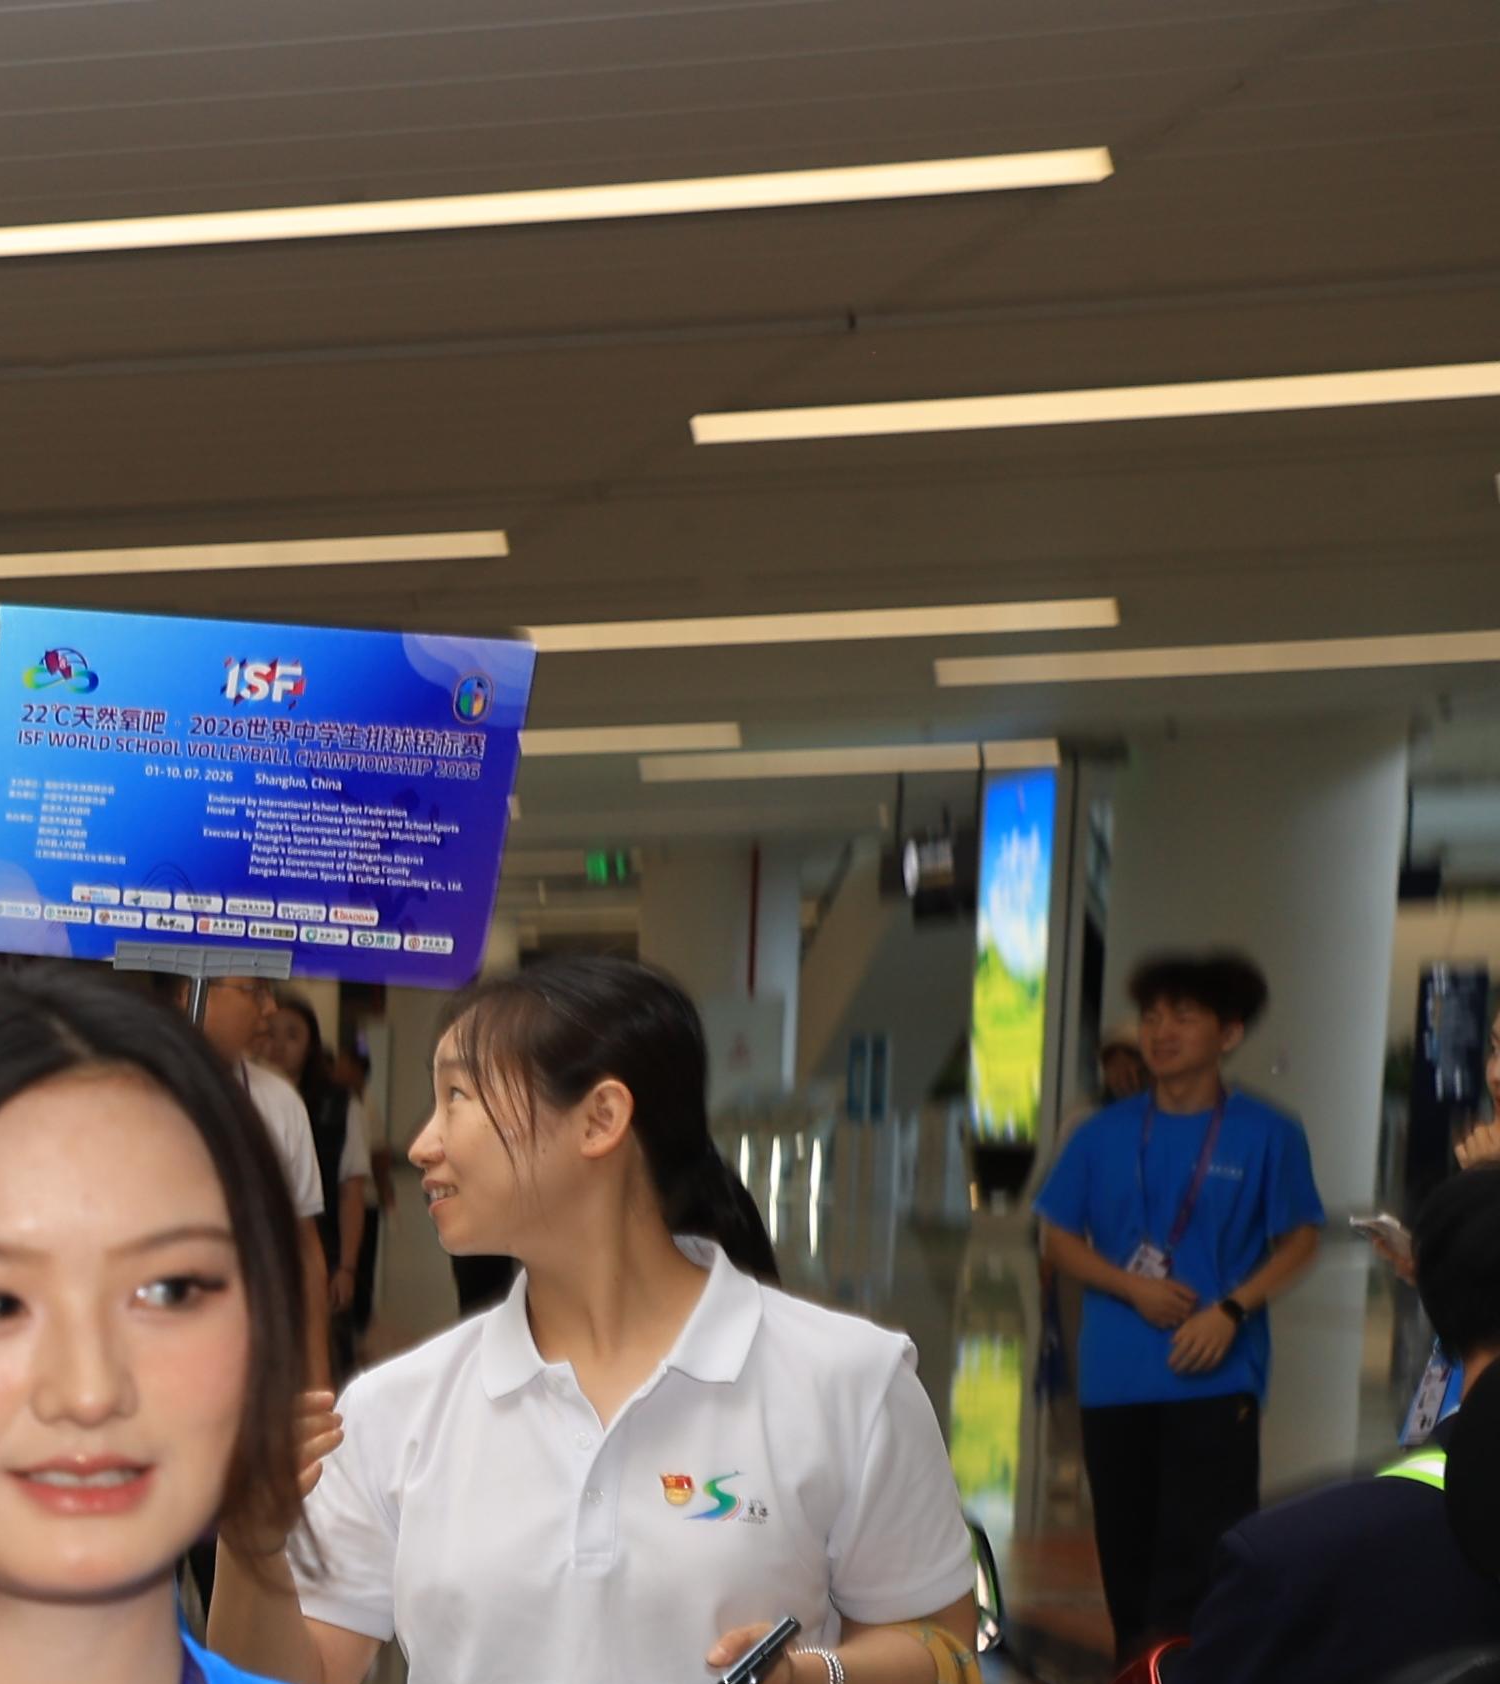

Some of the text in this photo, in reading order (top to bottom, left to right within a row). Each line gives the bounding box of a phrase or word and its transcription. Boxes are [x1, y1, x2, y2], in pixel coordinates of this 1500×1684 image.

[225, 663, 303, 703] ISF
[19, 730, 481, 780] ISF WORLD SCHOOL VOLLEYBALL CHAMPIONSHIP 2026
[205, 769, 234, 782] 2026
[254, 772, 308, 791] Shangluo,
[311, 774, 343, 791] China
